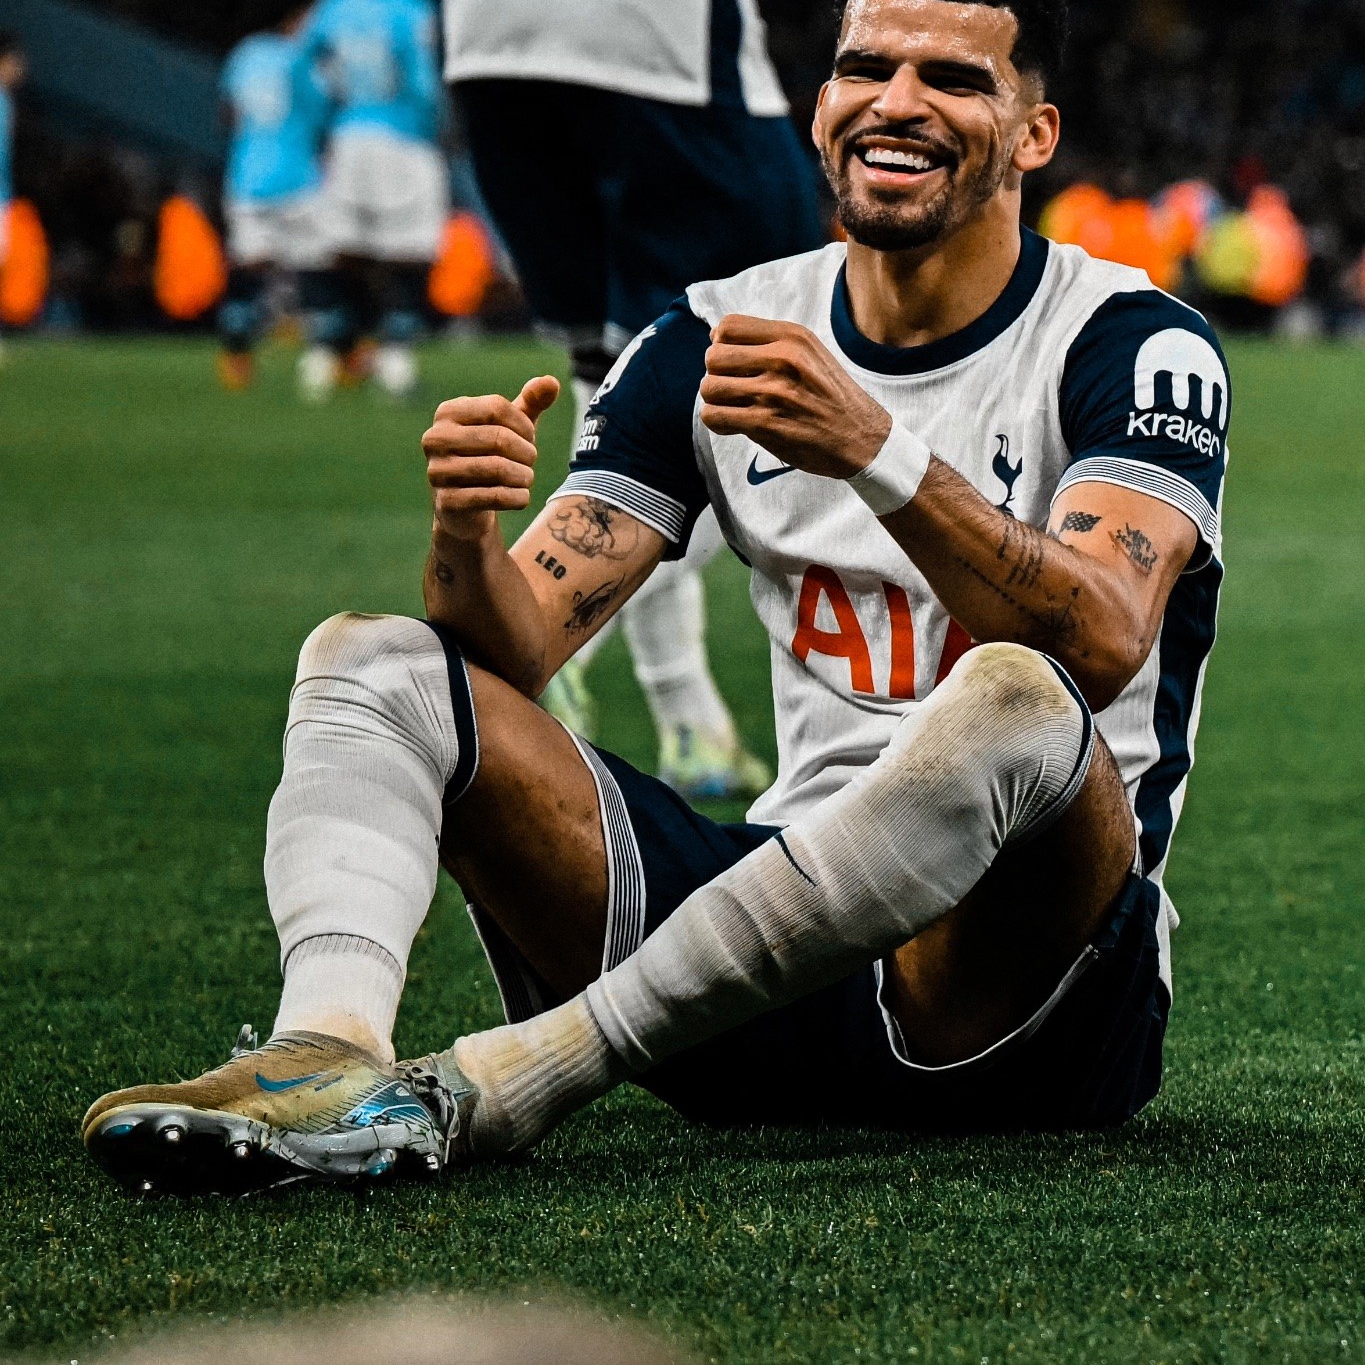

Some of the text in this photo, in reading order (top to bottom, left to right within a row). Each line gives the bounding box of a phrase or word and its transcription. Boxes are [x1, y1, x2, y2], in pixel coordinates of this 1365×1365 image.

[1126, 411, 1220, 457] kraken
[534, 549, 567, 580] LEO
[792, 565, 981, 701] AI
